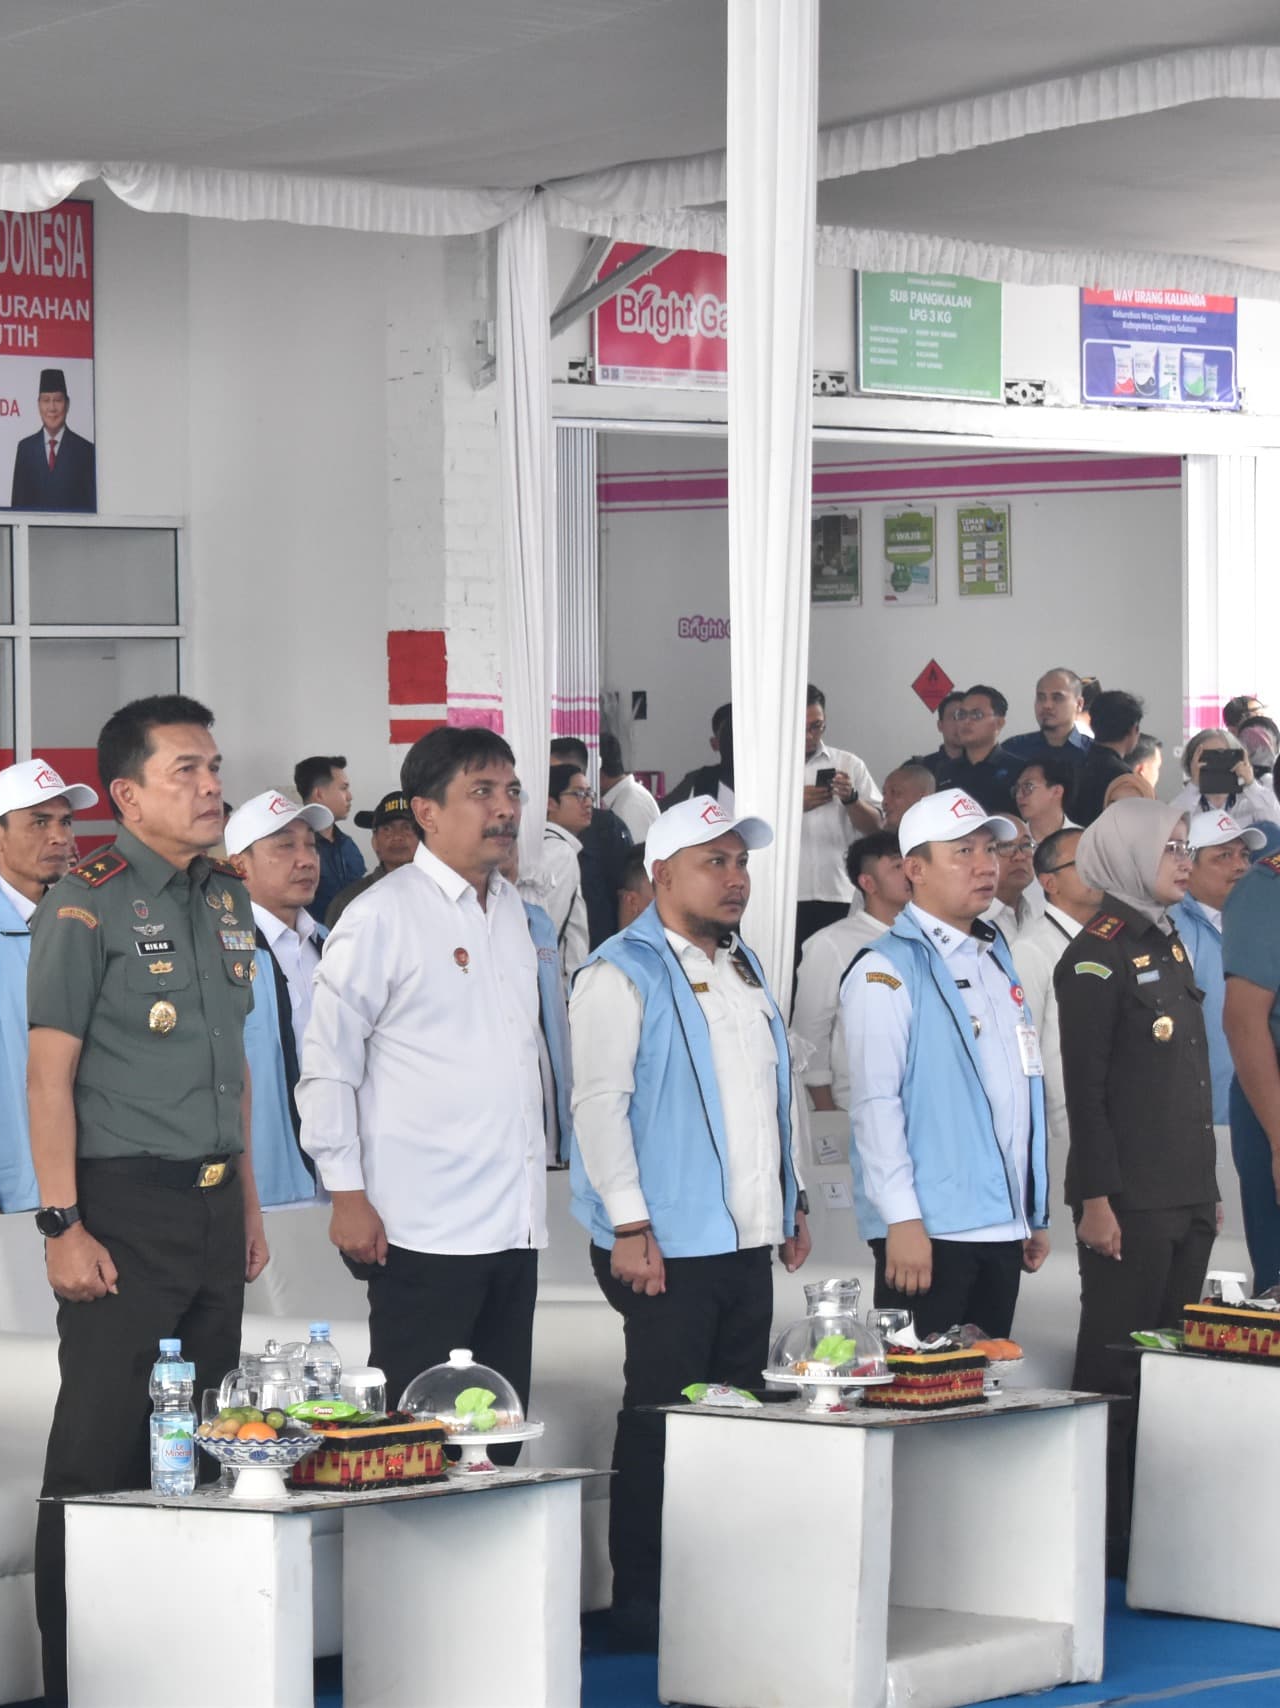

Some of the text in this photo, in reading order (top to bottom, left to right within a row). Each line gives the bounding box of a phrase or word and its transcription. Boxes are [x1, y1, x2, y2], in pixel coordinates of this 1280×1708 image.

[889, 289, 972, 308] SUB PANGKALAN
[618, 286, 697, 341] Bright
[909, 307, 952, 324] LPG 3 KG
[678, 615, 724, 642] Bright
